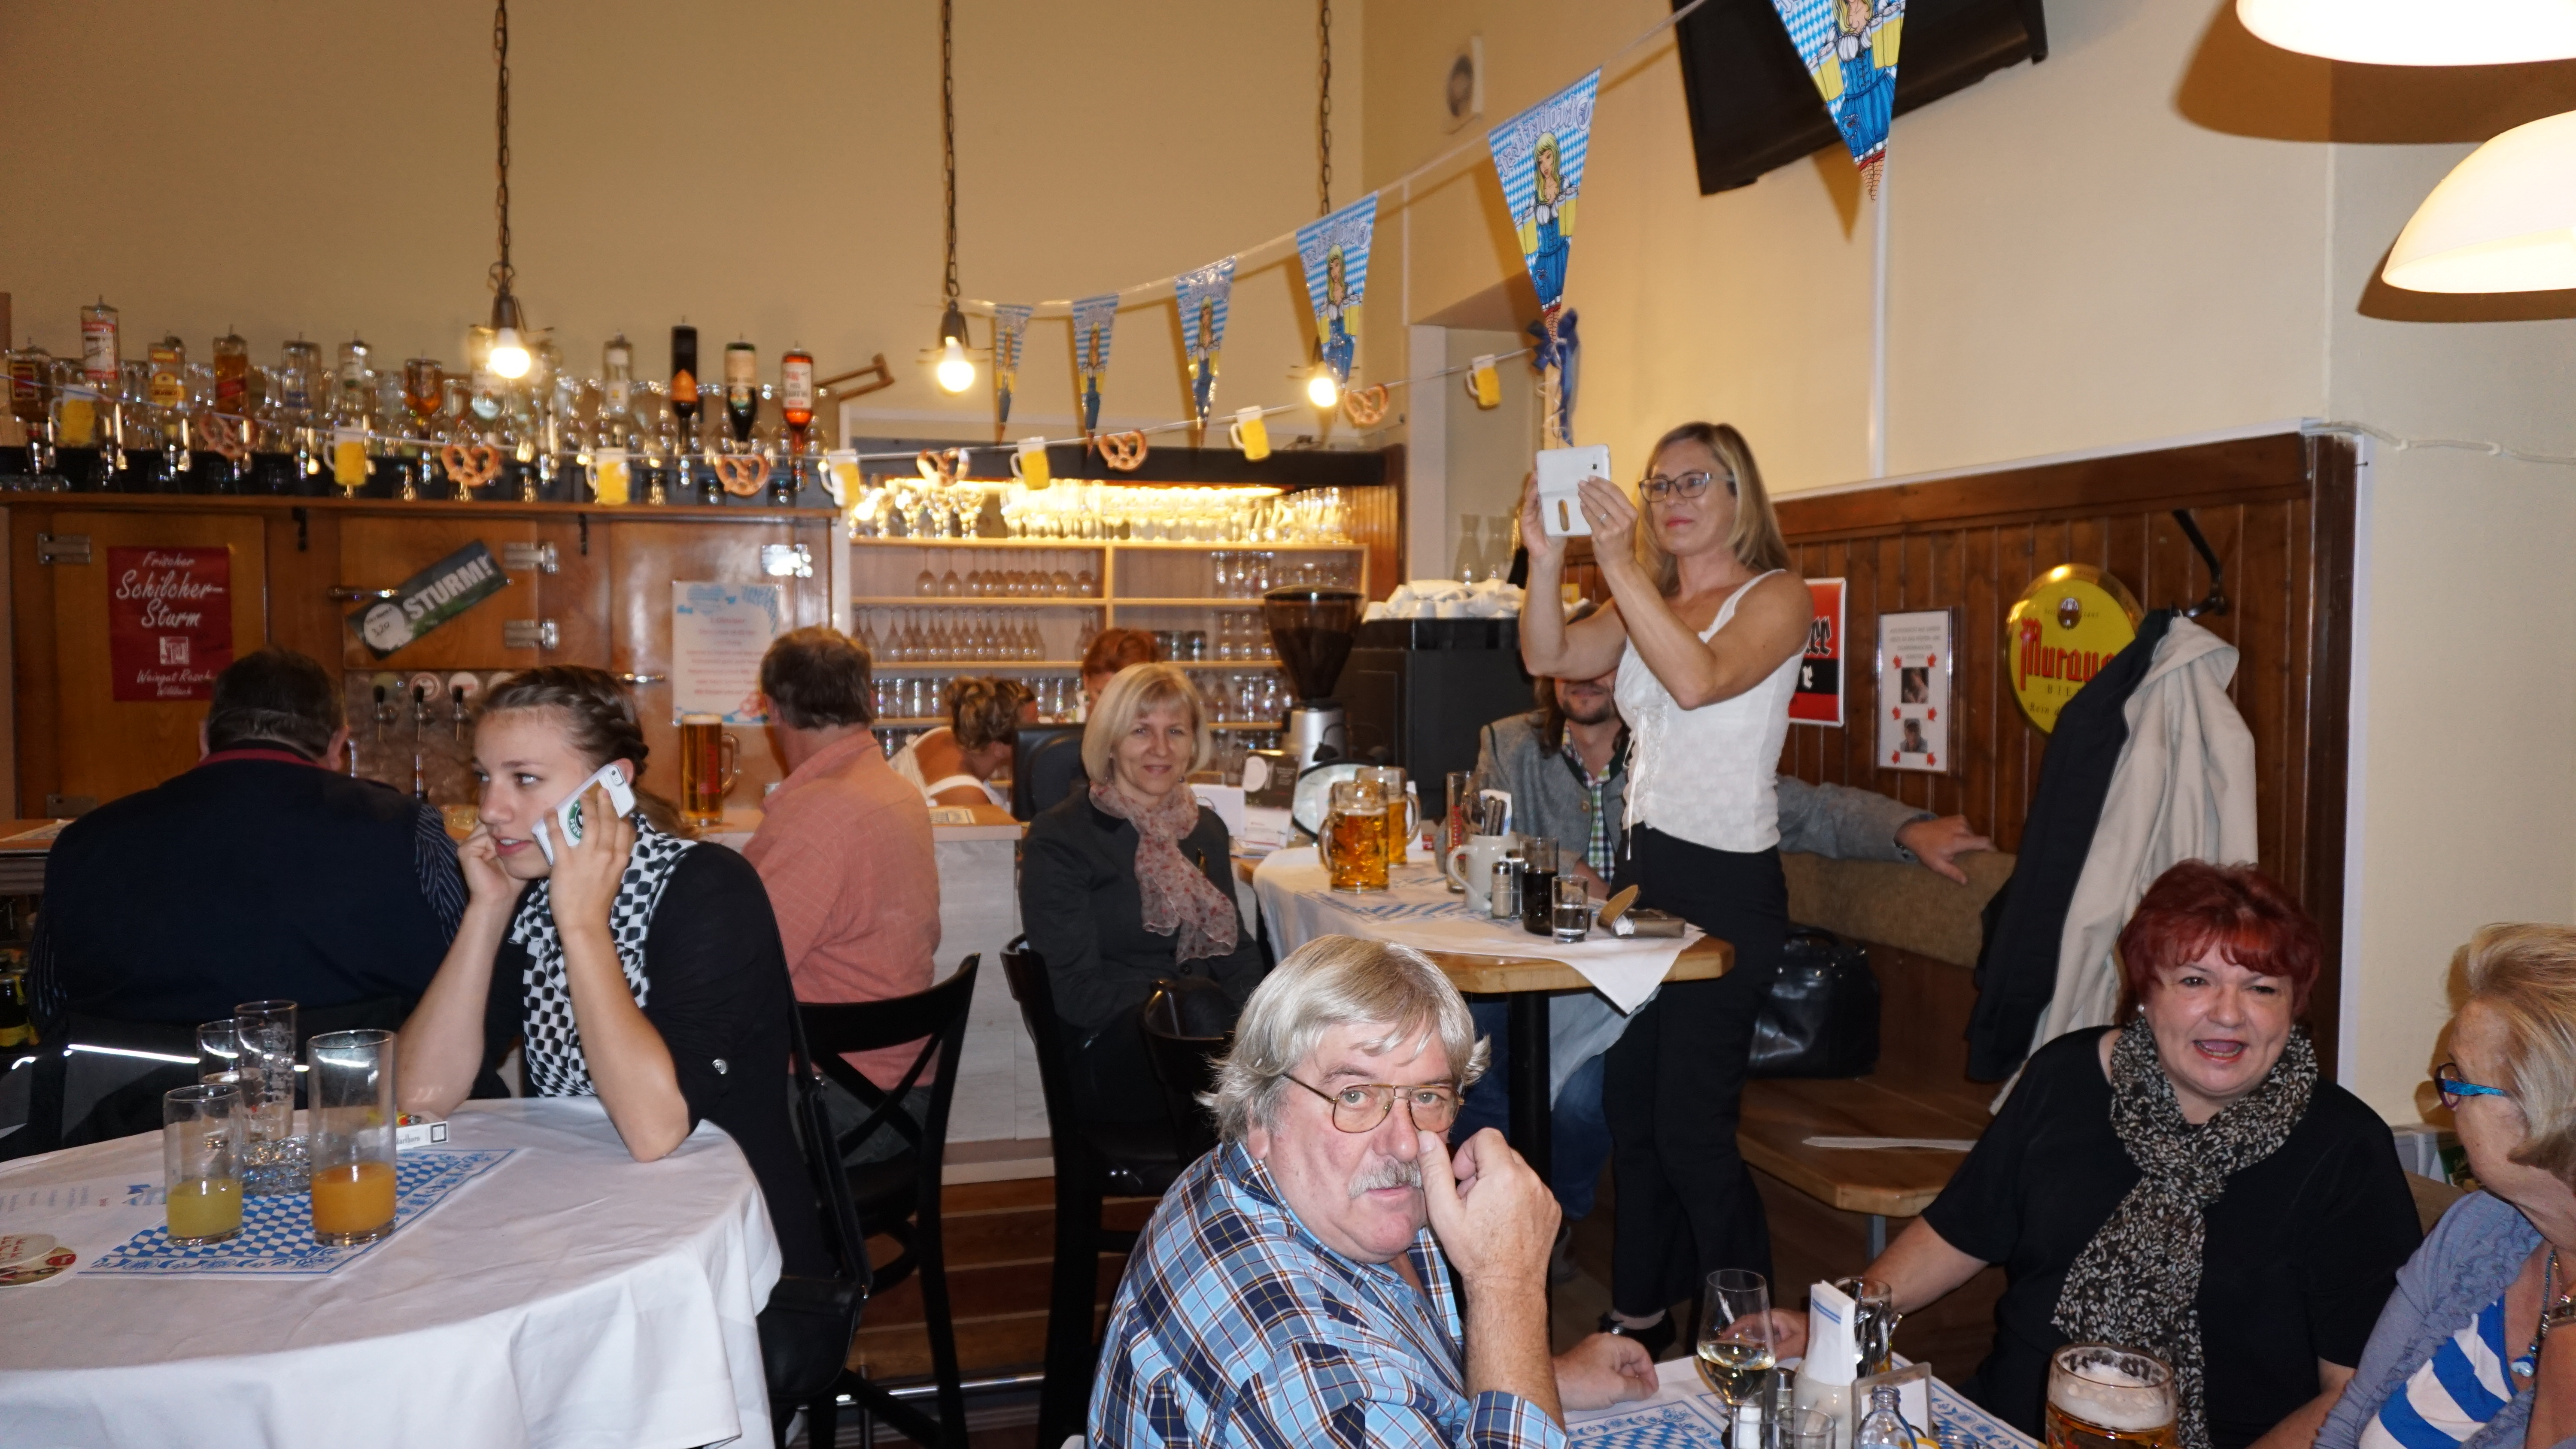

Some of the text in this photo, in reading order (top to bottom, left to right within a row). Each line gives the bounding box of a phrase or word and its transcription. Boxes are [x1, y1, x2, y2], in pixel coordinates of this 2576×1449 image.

[116, 569, 224, 600] Schilcher-
[402, 554, 495, 620] STURM!
[141, 598, 201, 628] Sturm
